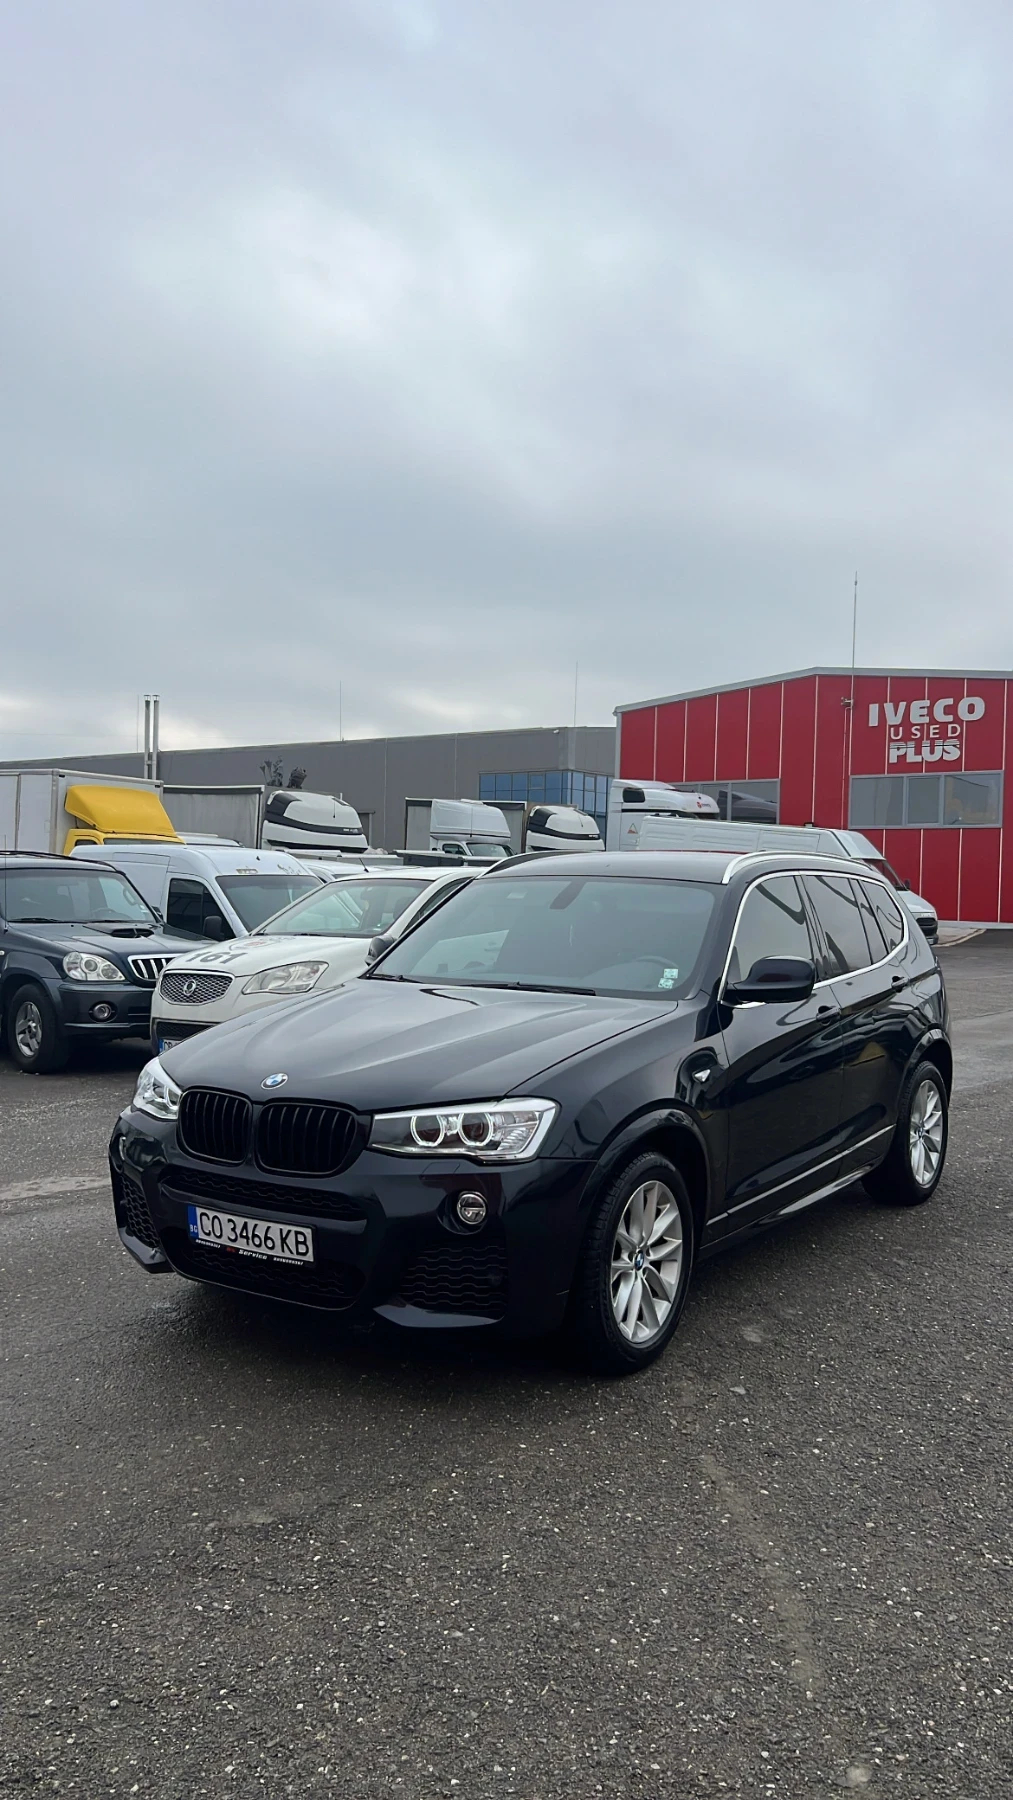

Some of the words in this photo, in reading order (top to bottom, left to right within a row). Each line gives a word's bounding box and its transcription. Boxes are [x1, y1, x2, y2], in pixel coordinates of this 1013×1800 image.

[868, 696, 986, 727] IVECO
[890, 723, 961, 740] USED
[888, 738, 961, 764] PLUS
[185, 951, 248, 964] 161
